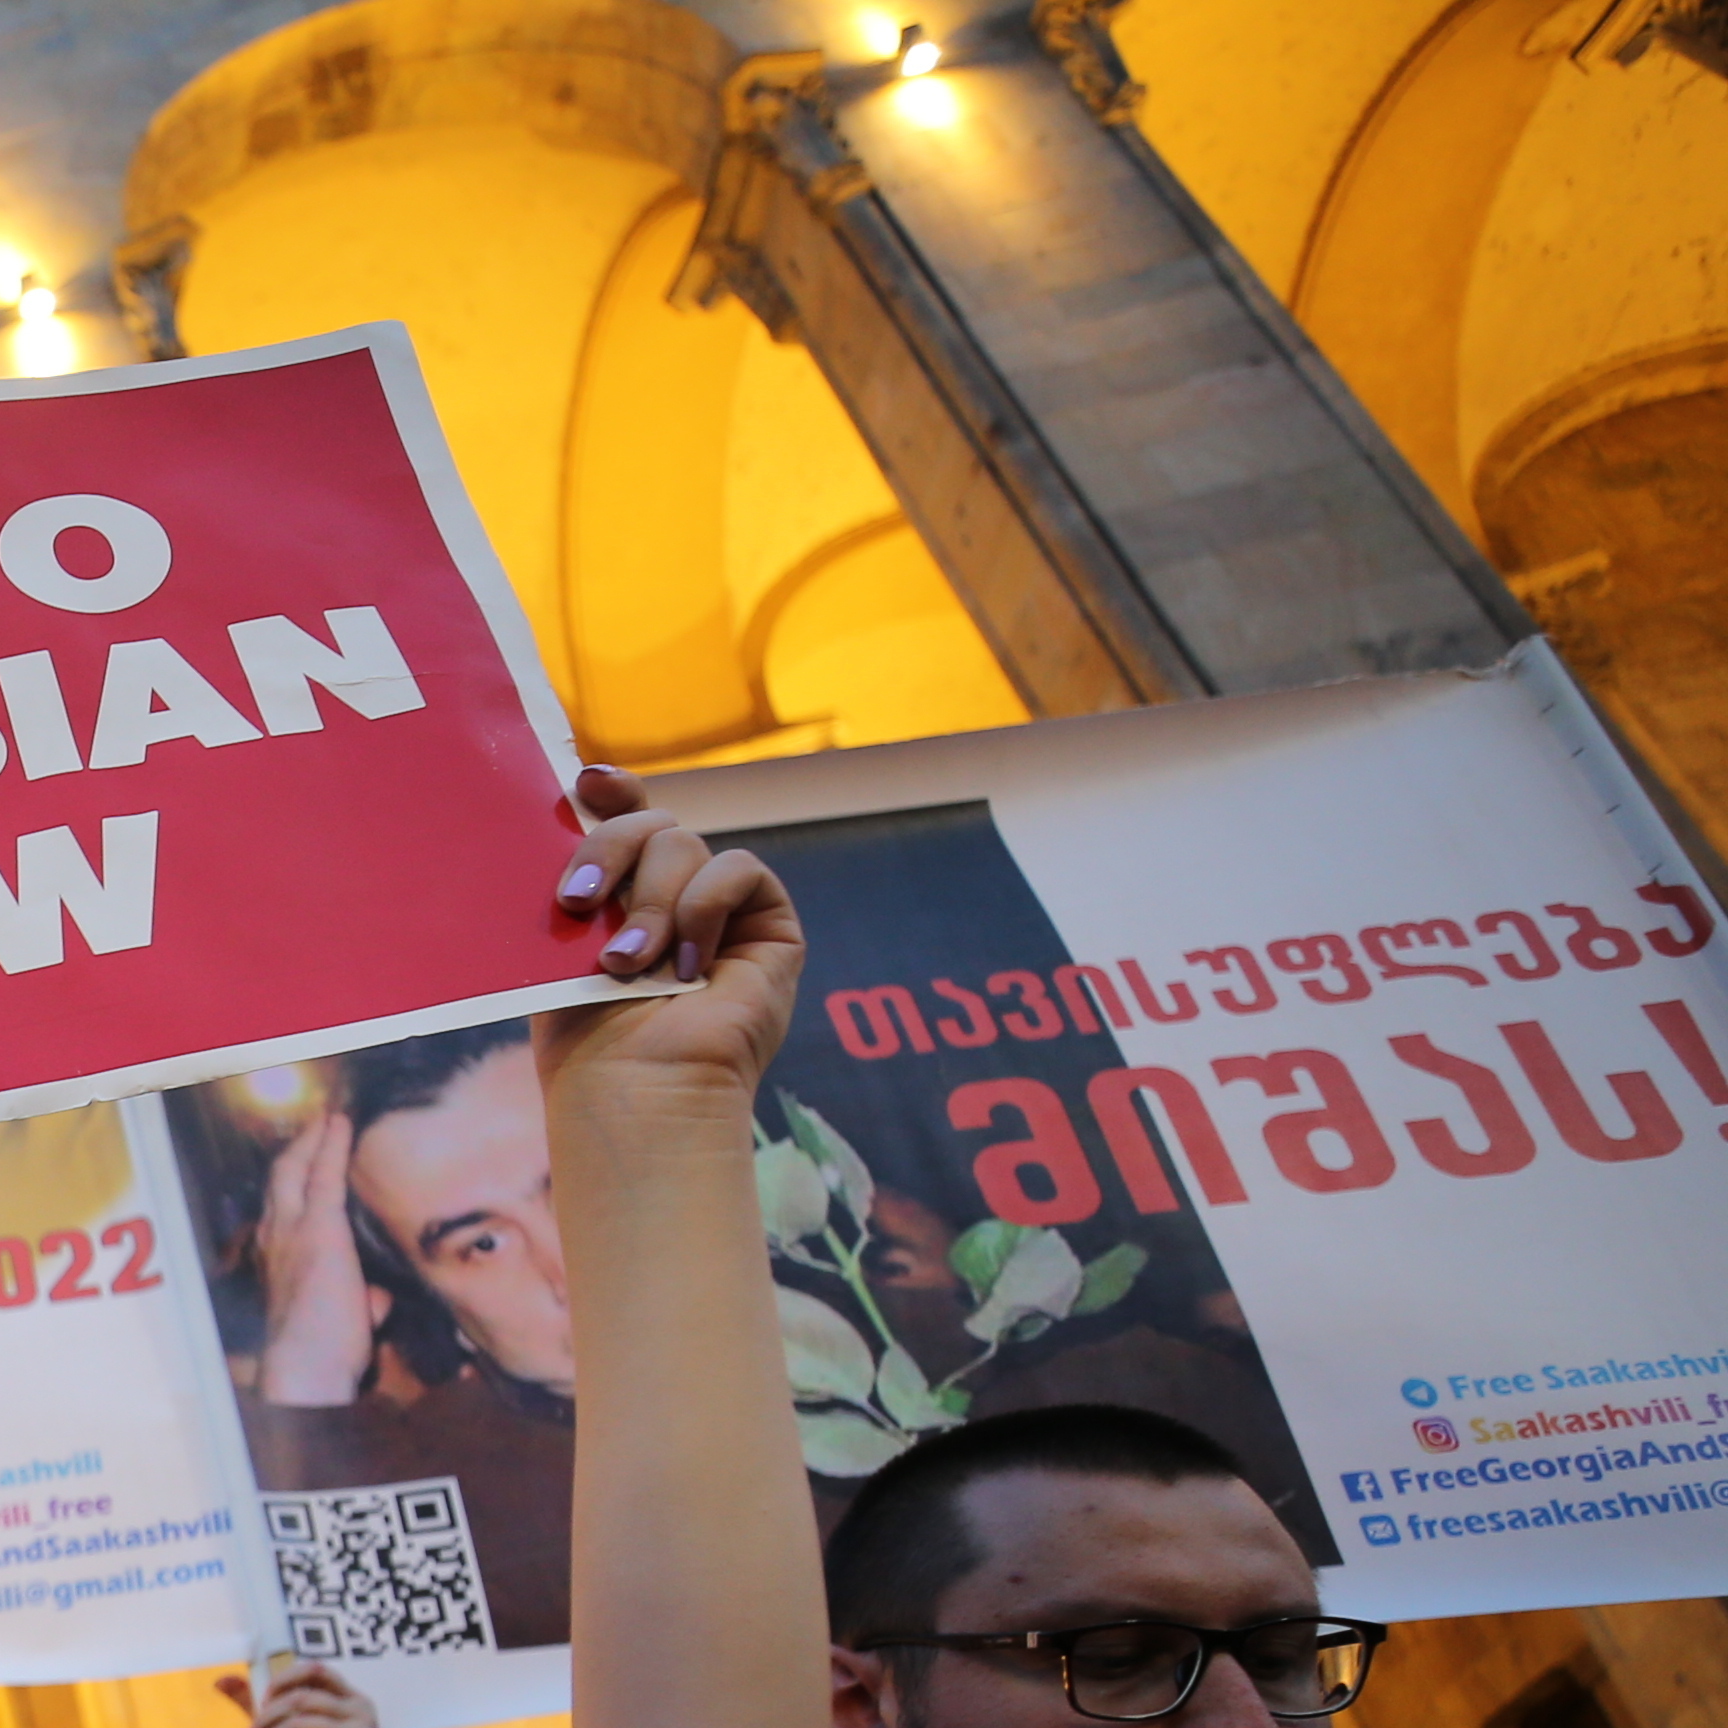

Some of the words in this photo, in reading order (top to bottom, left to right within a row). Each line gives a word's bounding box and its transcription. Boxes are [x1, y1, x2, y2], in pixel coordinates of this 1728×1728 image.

[824, 880, 1716, 1061] თავისუფლება
[1447, 1373, 1536, 1401] Free
[1468, 1392, 1728, 1445] Saakashvili_f
